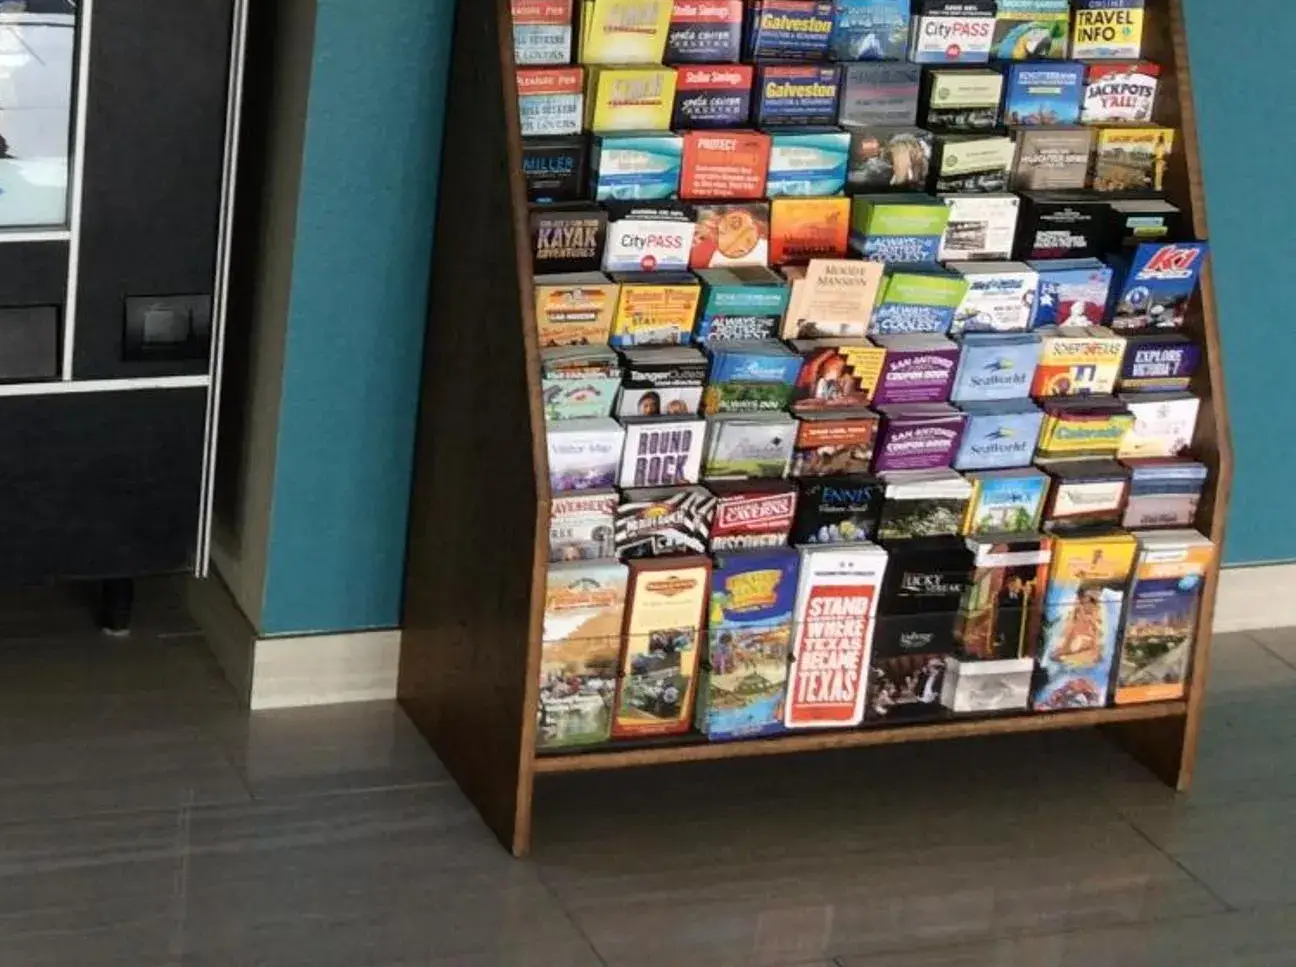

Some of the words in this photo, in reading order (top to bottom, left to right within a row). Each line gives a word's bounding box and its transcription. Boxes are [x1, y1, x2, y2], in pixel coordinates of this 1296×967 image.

[761, 14, 833, 33] Galveston
[1077, 10, 1134, 26] TRAVEL
[925, 21, 991, 41] CityPASS
[1077, 26, 1116, 43] INFO
[765, 81, 836, 99] Galveston
[1089, 83, 1154, 99] JACKPOTS
[523, 155, 574, 171] MILLER
[536, 227, 600, 249] KAYAK
[620, 233, 683, 249] CityPASS
[825, 264, 867, 275] MOODY
[817, 274, 868, 287] MANSION
[1135, 349, 1184, 363] EXPLORE
[890, 358, 912, 371] SAN
[970, 372, 1027, 388] SeaWorld
[638, 429, 693, 456] ROUND
[891, 432, 914, 444] SAN
[970, 441, 1029, 455] SeaWorld
[633, 454, 689, 487] ROCK
[725, 503, 790, 522] CAVERNS
[807, 596, 869, 618] STAND
[806, 618, 866, 639] WHERE
[803, 638, 863, 651] TEXAS
[800, 650, 861, 670] BECAME
[797, 669, 858, 703] TEXAS
